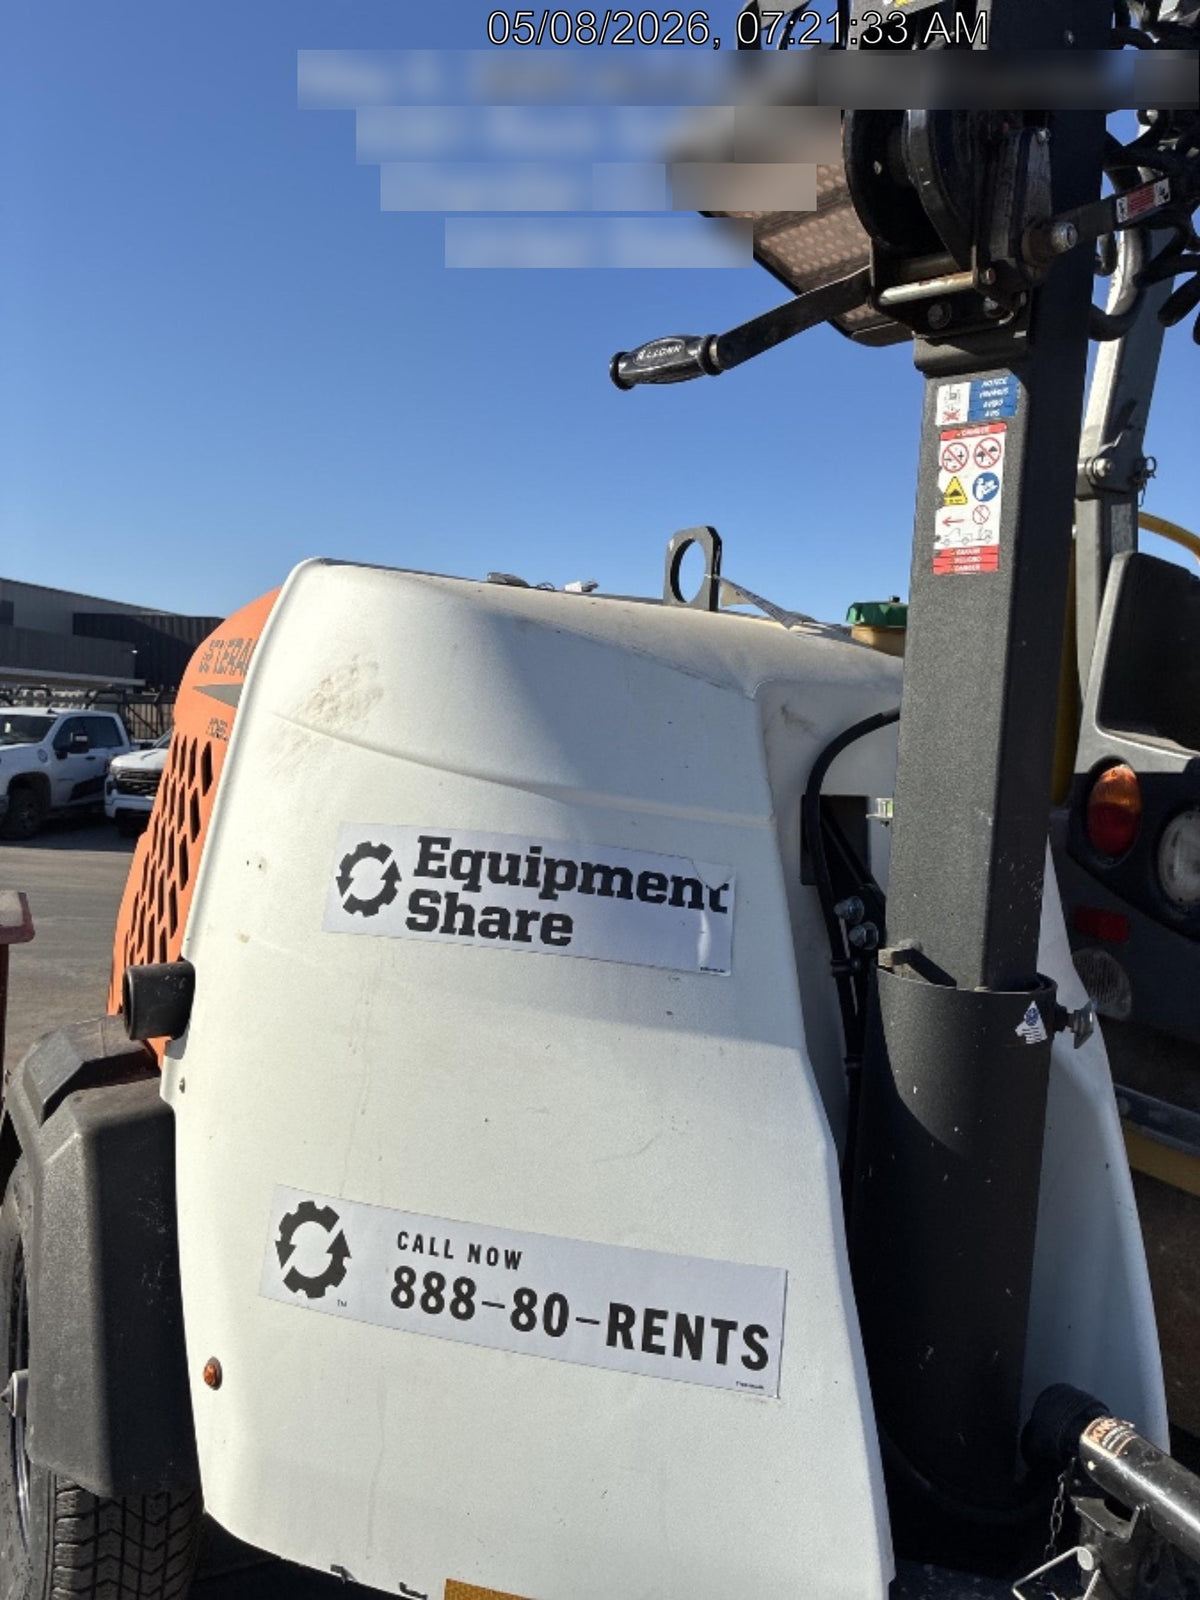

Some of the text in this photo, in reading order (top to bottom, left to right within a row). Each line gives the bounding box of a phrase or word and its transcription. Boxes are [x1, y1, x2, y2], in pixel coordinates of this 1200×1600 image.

[414, 835, 730, 915] Equipment
[405, 889, 574, 947] Share
[396, 1231, 522, 1271] CALL NOW
[390, 1265, 769, 1371] 888-80-RENTS
